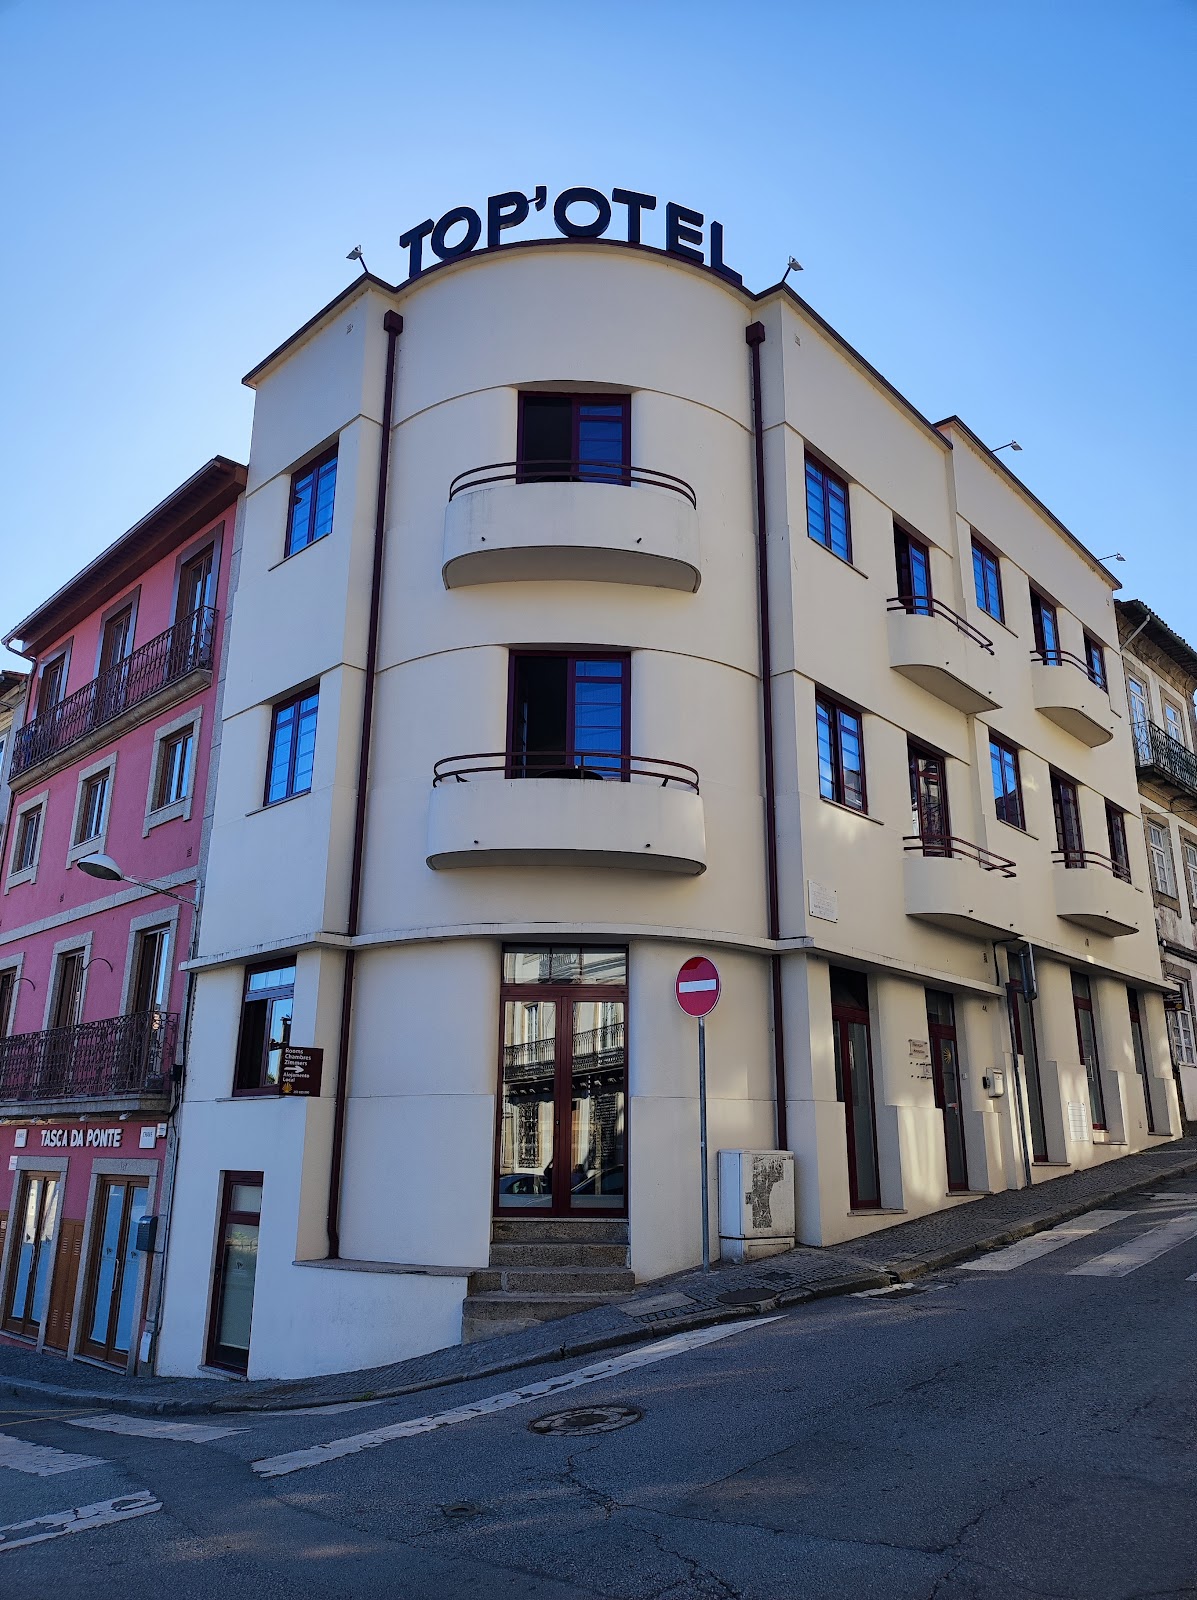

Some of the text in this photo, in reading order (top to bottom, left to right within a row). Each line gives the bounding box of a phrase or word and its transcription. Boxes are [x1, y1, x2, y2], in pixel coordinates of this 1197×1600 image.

[400, 185, 743, 286] TOP'OTEL
[41, 1128, 122, 1147] TASCA DA PONTE
